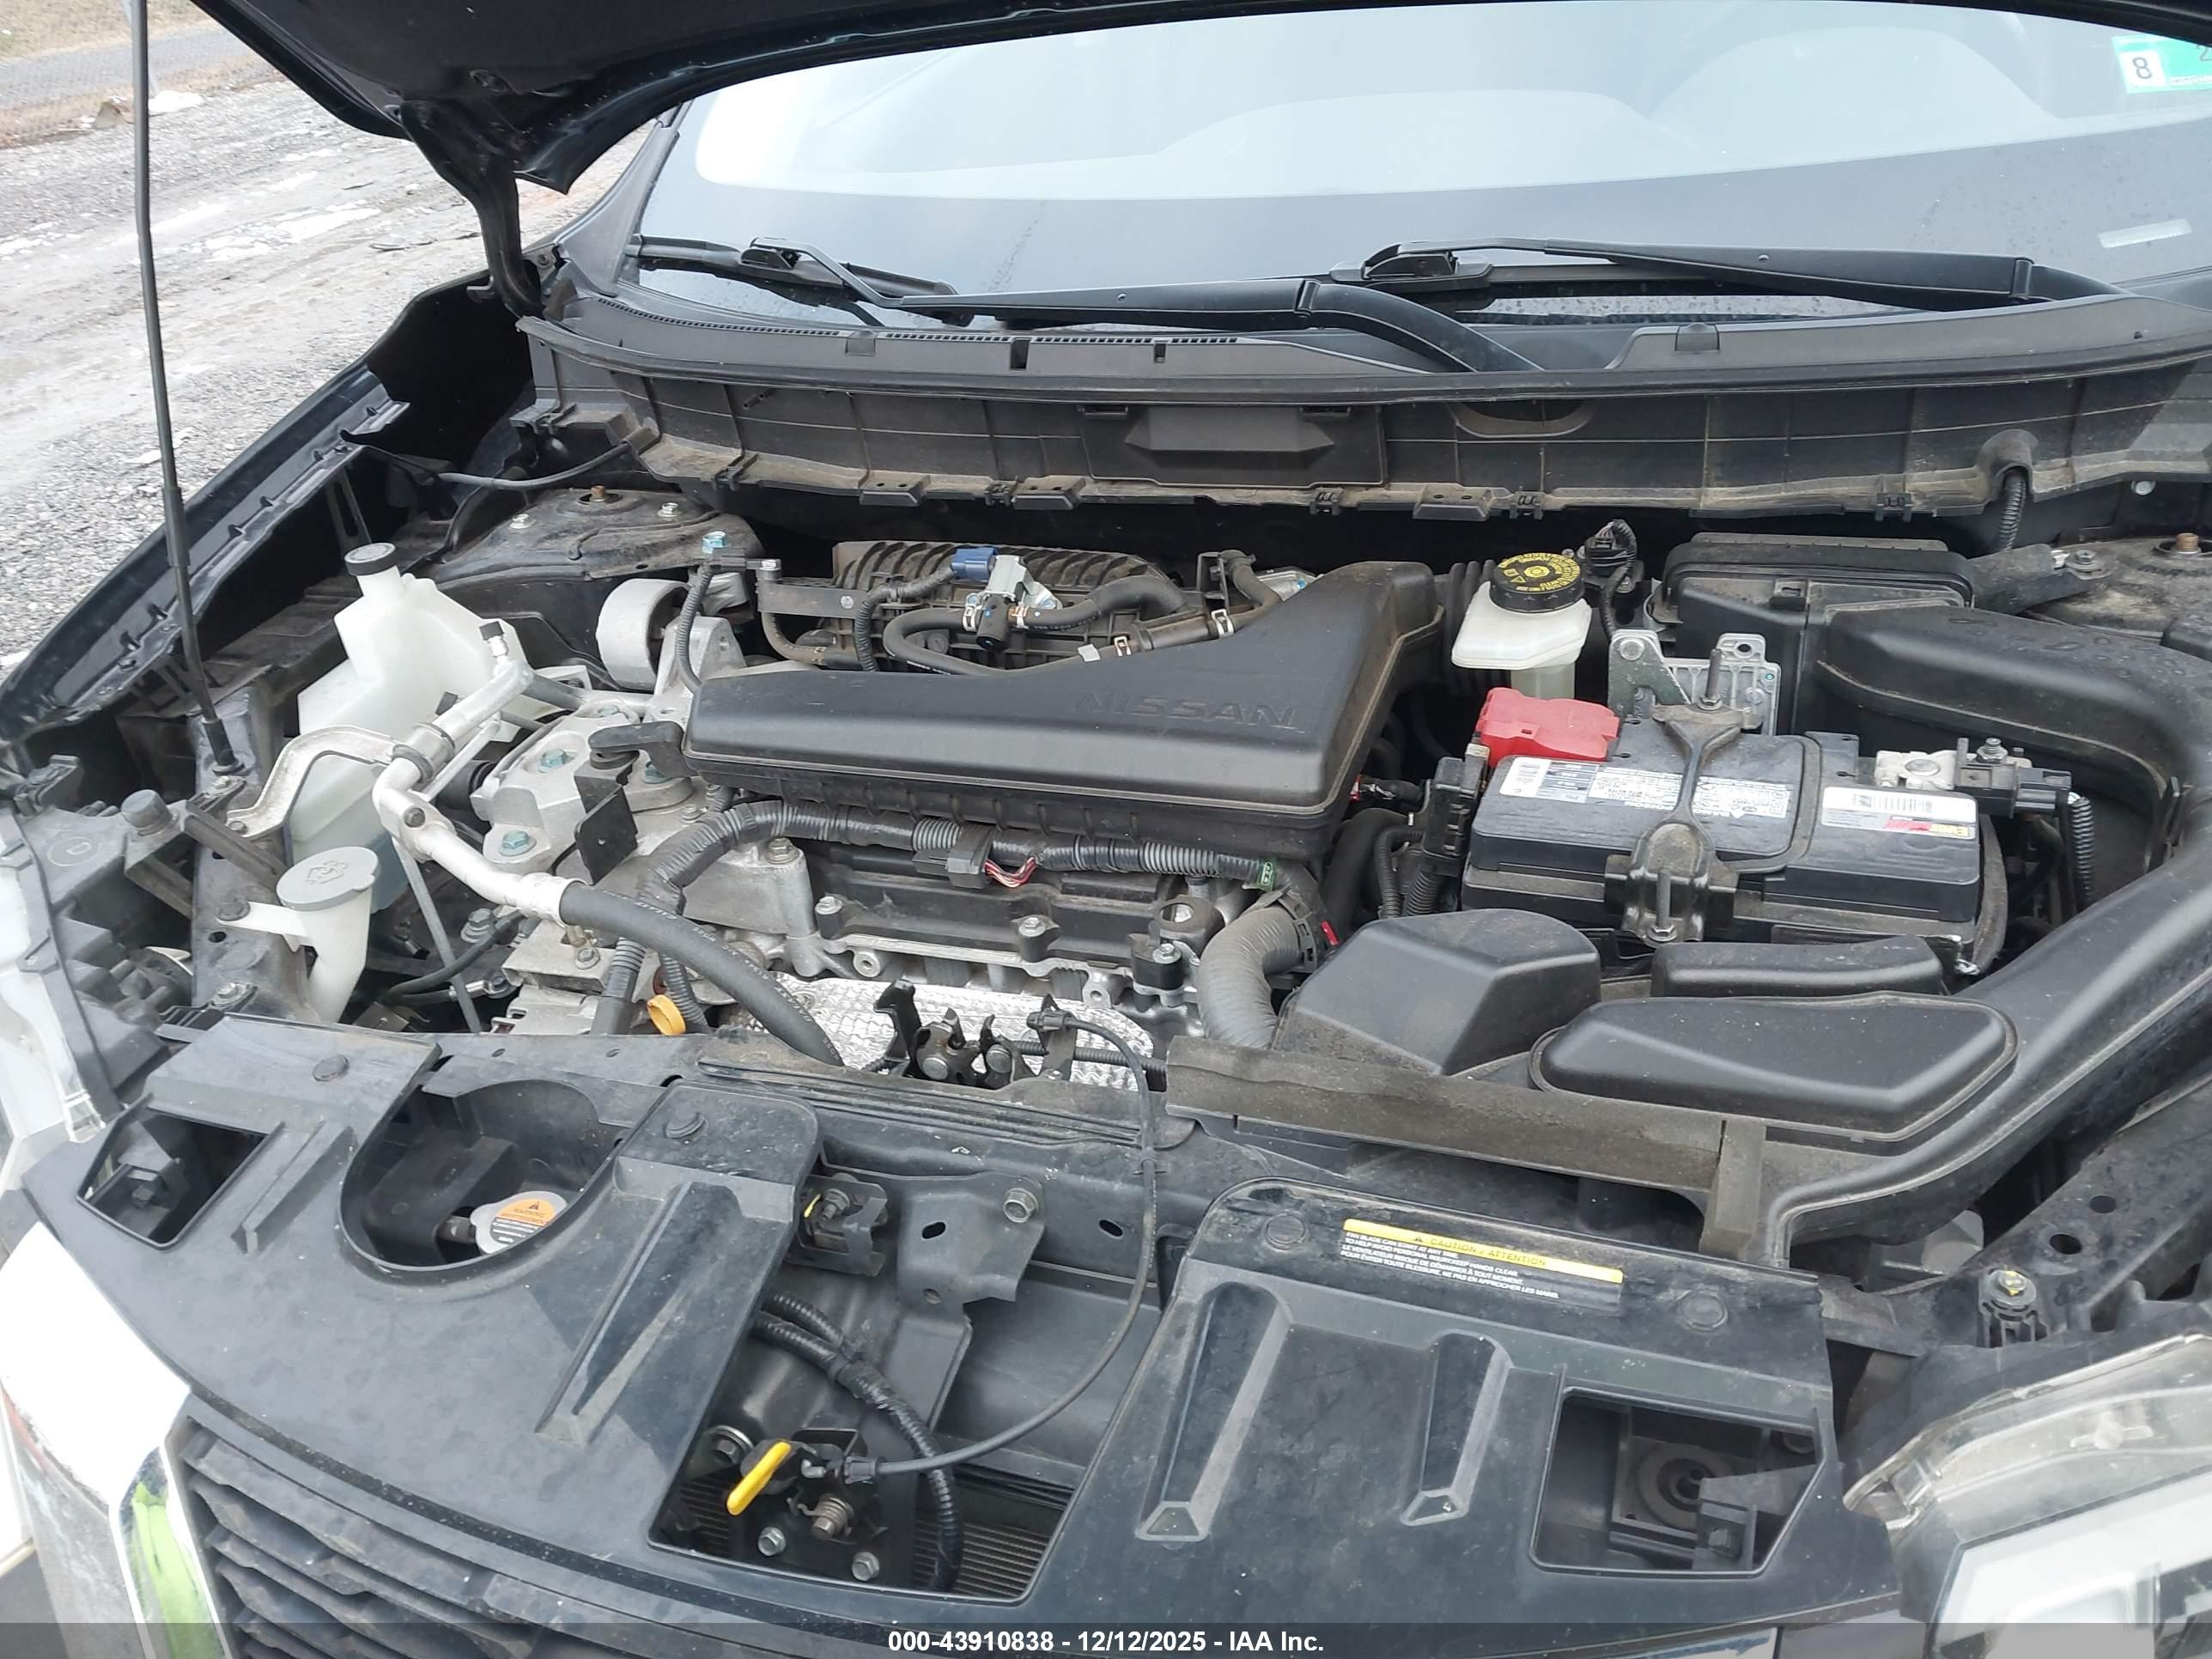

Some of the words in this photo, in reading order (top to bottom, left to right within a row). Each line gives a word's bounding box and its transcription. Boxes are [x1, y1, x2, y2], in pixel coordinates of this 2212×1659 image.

[2131, 57, 2153, 79] 8
[1073, 692, 1305, 733] NISSAN
[1355, 1239, 1371, 1248] HELP
[1431, 1237, 1475, 1253] CAUTION
[1488, 1249, 1545, 1266] ATTENTION
[1474, 1270, 1491, 1279] TOUT
[1522, 1285, 1534, 1294] LES
